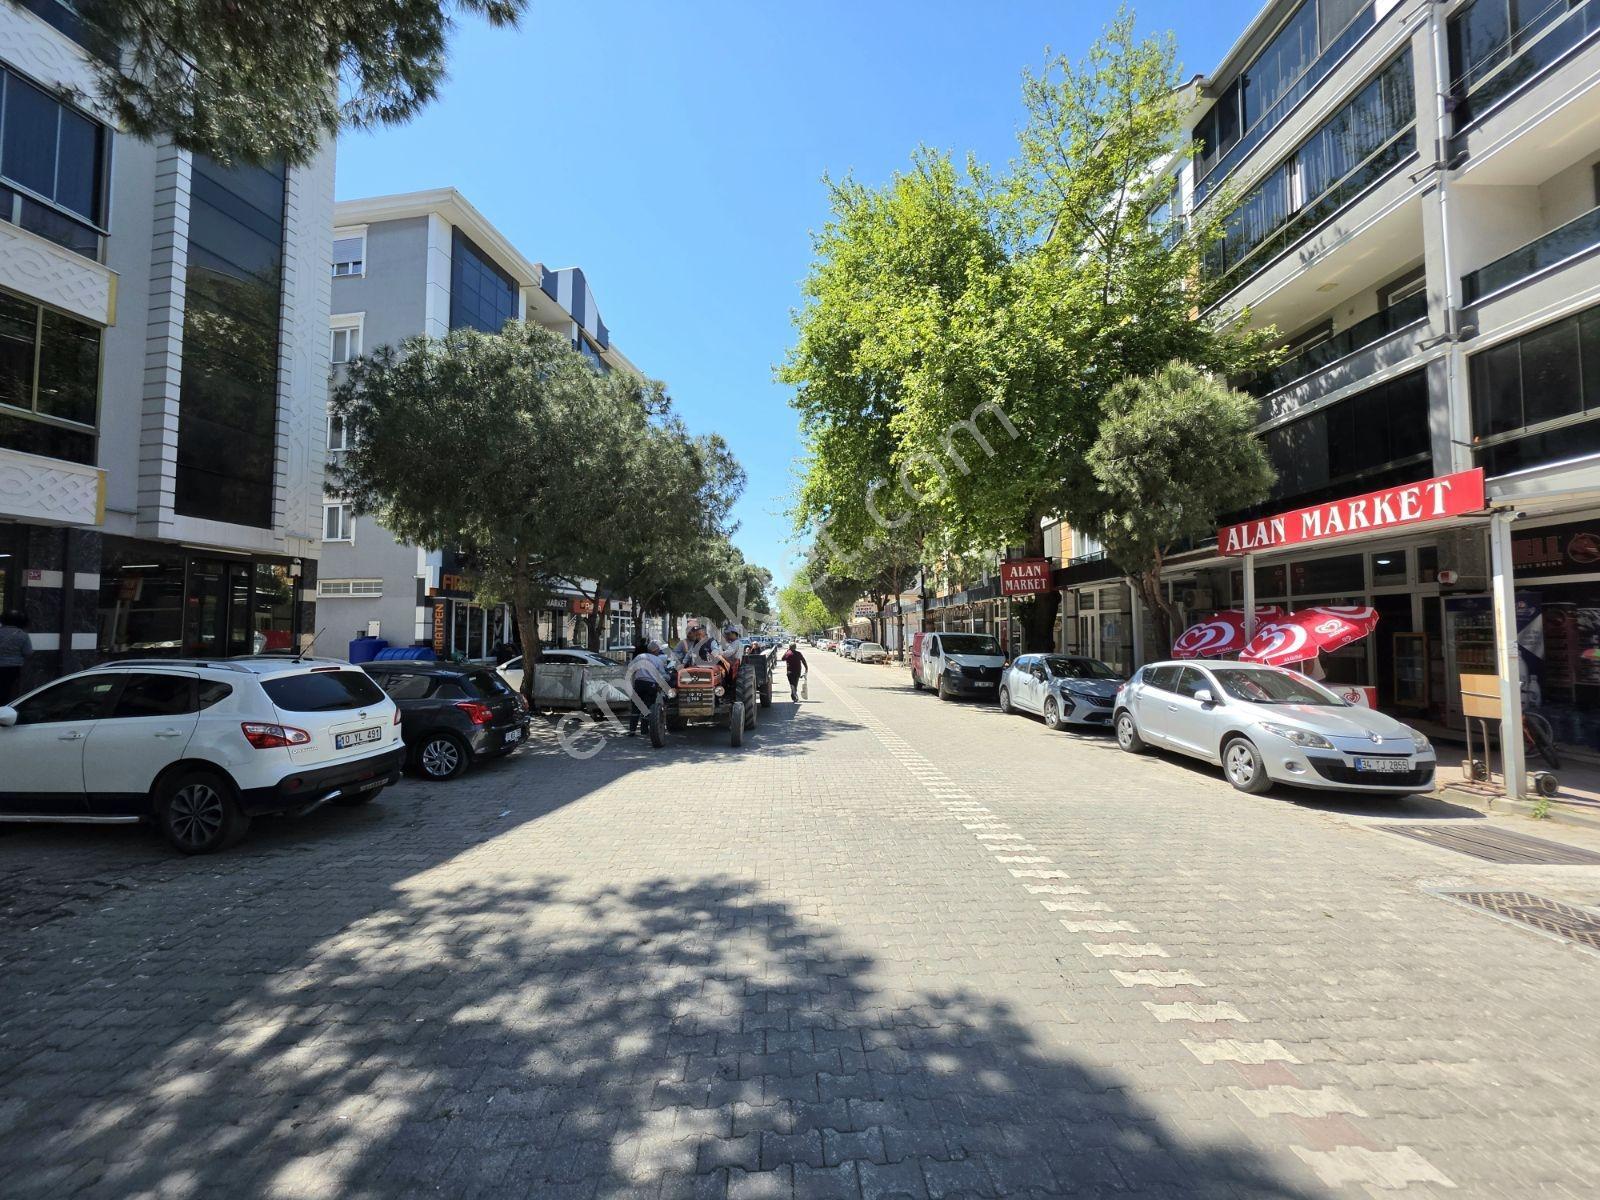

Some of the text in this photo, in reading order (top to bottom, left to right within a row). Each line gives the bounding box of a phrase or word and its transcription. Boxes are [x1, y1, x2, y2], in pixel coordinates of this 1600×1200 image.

[1226, 480, 1452, 551] ALAN MARKET
[1010, 565, 1042, 577] ALAN
[1005, 578, 1047, 590] MARKET
[434, 603, 444, 656] FIRATPEN
[341, 735, 350, 744] 10
[354, 733, 363, 742] YL
[367, 729, 379, 739] 491
[1361, 760, 1371, 768] 34
[1389, 760, 1407, 769] 2855
